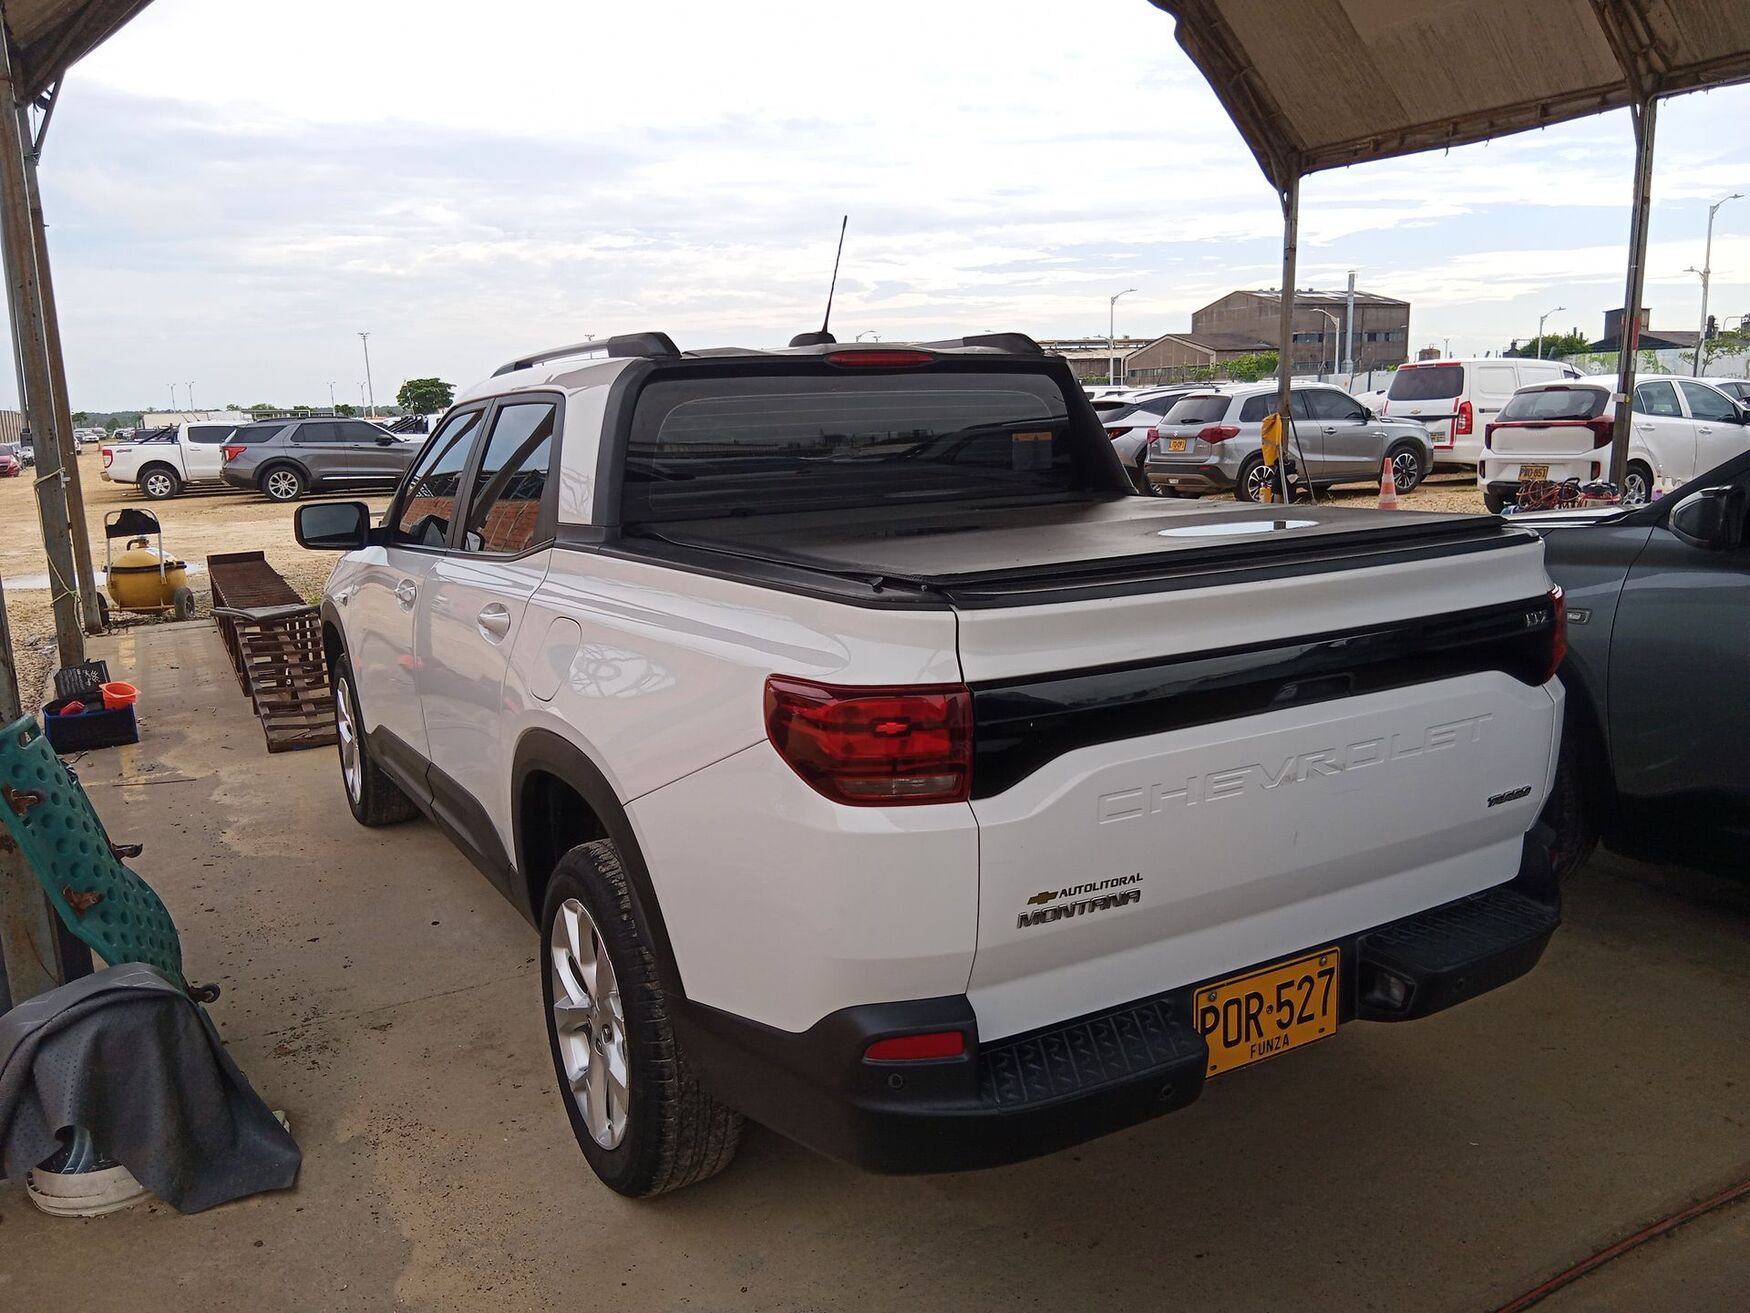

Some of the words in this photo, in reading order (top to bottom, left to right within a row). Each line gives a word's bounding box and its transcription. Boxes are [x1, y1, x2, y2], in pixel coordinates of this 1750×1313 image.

[1098, 712, 1493, 824] CHEVROLET
[1058, 872, 1144, 898] AUTOLITORAL
[1016, 887, 1141, 929] MONTANA
[1250, 1033, 1290, 1059] FUNZA
